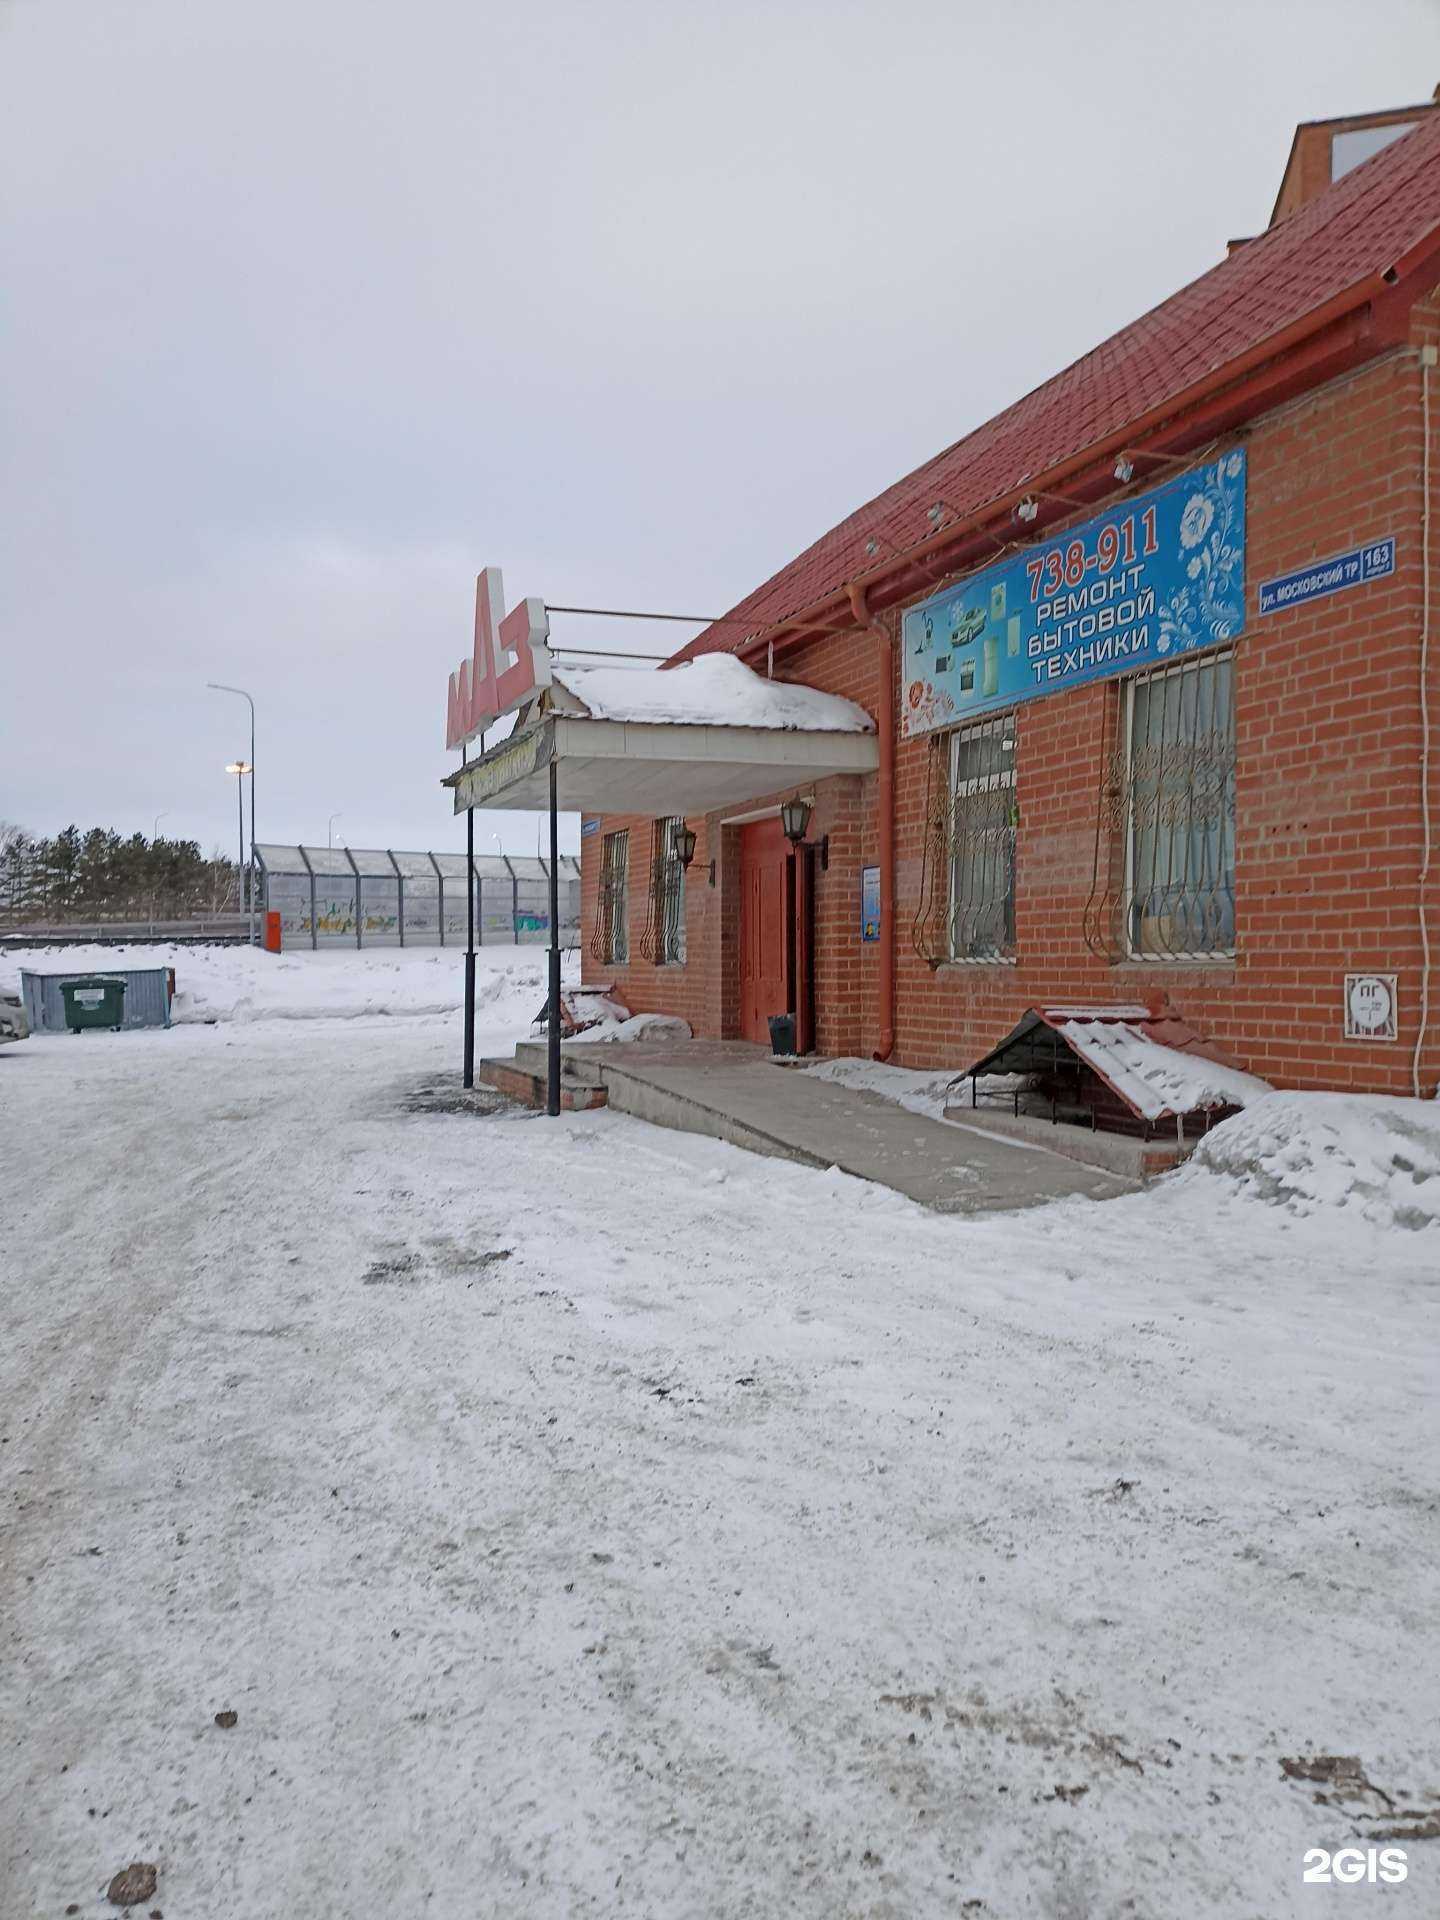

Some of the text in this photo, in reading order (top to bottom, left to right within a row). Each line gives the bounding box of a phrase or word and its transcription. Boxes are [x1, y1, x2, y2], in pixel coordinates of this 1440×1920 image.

[1027, 504, 1159, 604] 738-911
[1277, 563, 1344, 602] МОСКОВСКИЙ
[1365, 545, 1390, 569] 163
[1028, 586, 1156, 658] БЫТОВОЙ
[1036, 564, 1145, 628] РЕМОНТ
[1031, 624, 1149, 684] ТЕХНИКИ
